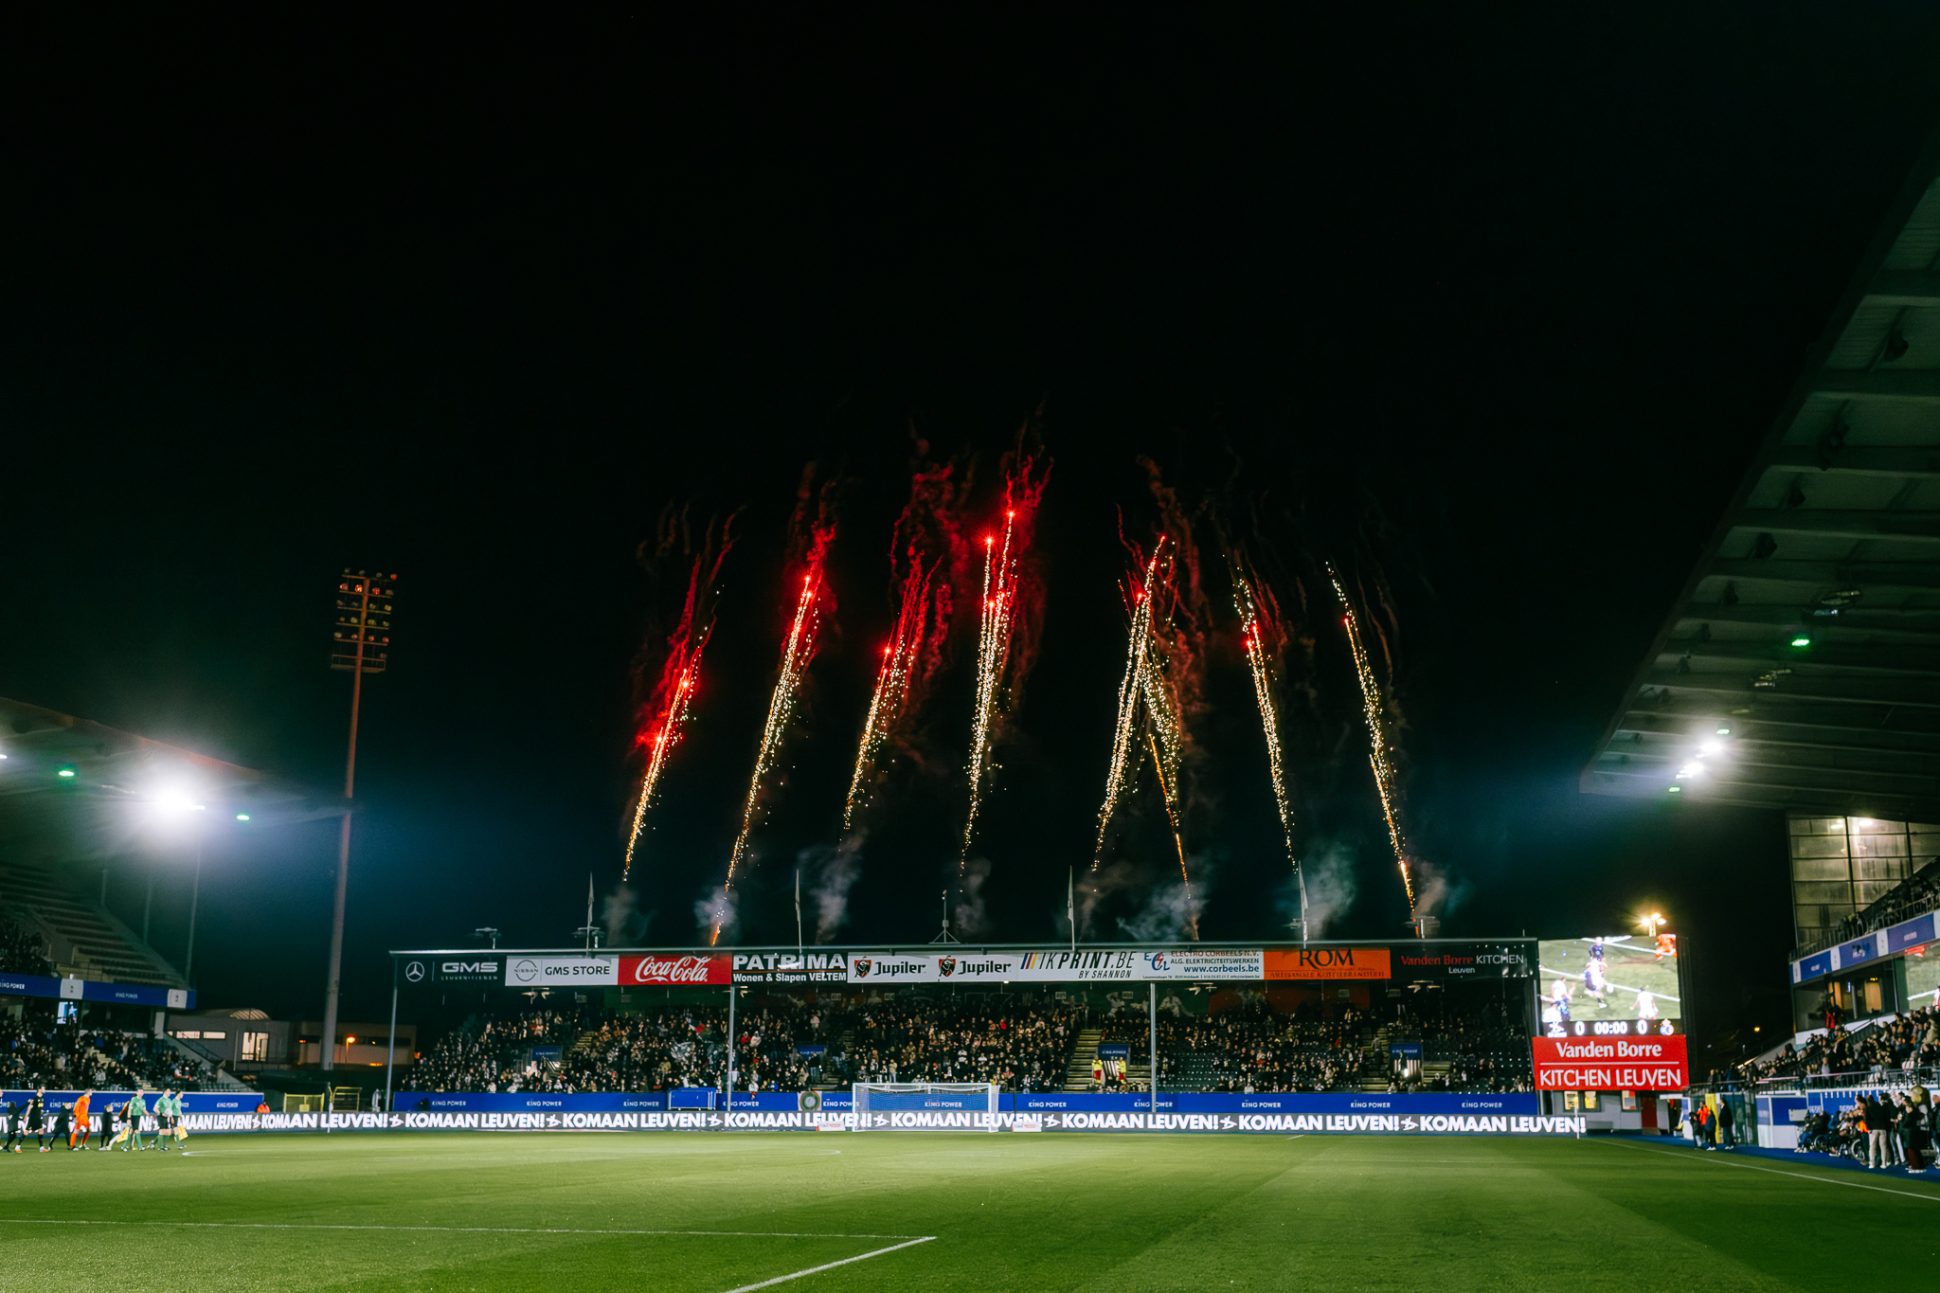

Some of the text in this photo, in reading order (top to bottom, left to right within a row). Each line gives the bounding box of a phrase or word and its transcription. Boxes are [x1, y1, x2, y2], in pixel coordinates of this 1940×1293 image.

[733, 953, 847, 970] PATRIMA
[1039, 951, 1137, 970] IKPRINT.BE
[1299, 948, 1354, 970] ROM
[1400, 954, 1525, 966] Vanden Borre KITCHEN
[441, 962, 498, 973] GMS
[544, 966, 611, 976] GMS STORE
[635, 955, 712, 983] Coca-Cola
[873, 961, 927, 977] Jupiler
[957, 959, 1012, 976] Jupiler
[1078, 970, 1090, 979] BY
[1091, 970, 1133, 978] SHANNON
[1183, 964, 1260, 973] www.corbeels.be
[1448, 966, 1476, 974] Leuven
[733, 972, 847, 983] Wonen & Slapen VELTEM
[1574, 1019, 1648, 1036] 0 00:00 0
[1555, 1040, 1663, 1058] Vanden Borre
[1539, 1068, 1682, 1087] KITCHEN LEUVEN
[215, 1114, 252, 1130] LEUVEN!
[261, 1113, 388, 1128] KOMAAN LEUVEN!
[404, 1113, 545, 1128] KOMAAN LEUVEN!
[562, 1113, 706, 1128] KOMAAN LEUVEN!
[724, 1112, 802, 1128] KOMAAN
[891, 1112, 971, 1128] KOMAAN
[1062, 1113, 1219, 1130] KOMAAN LEUVEN!
[1238, 1114, 1400, 1131] KOMAAN LEUVEN!
[1419, 1115, 1587, 1133] KOMAAN LEUVEN!
